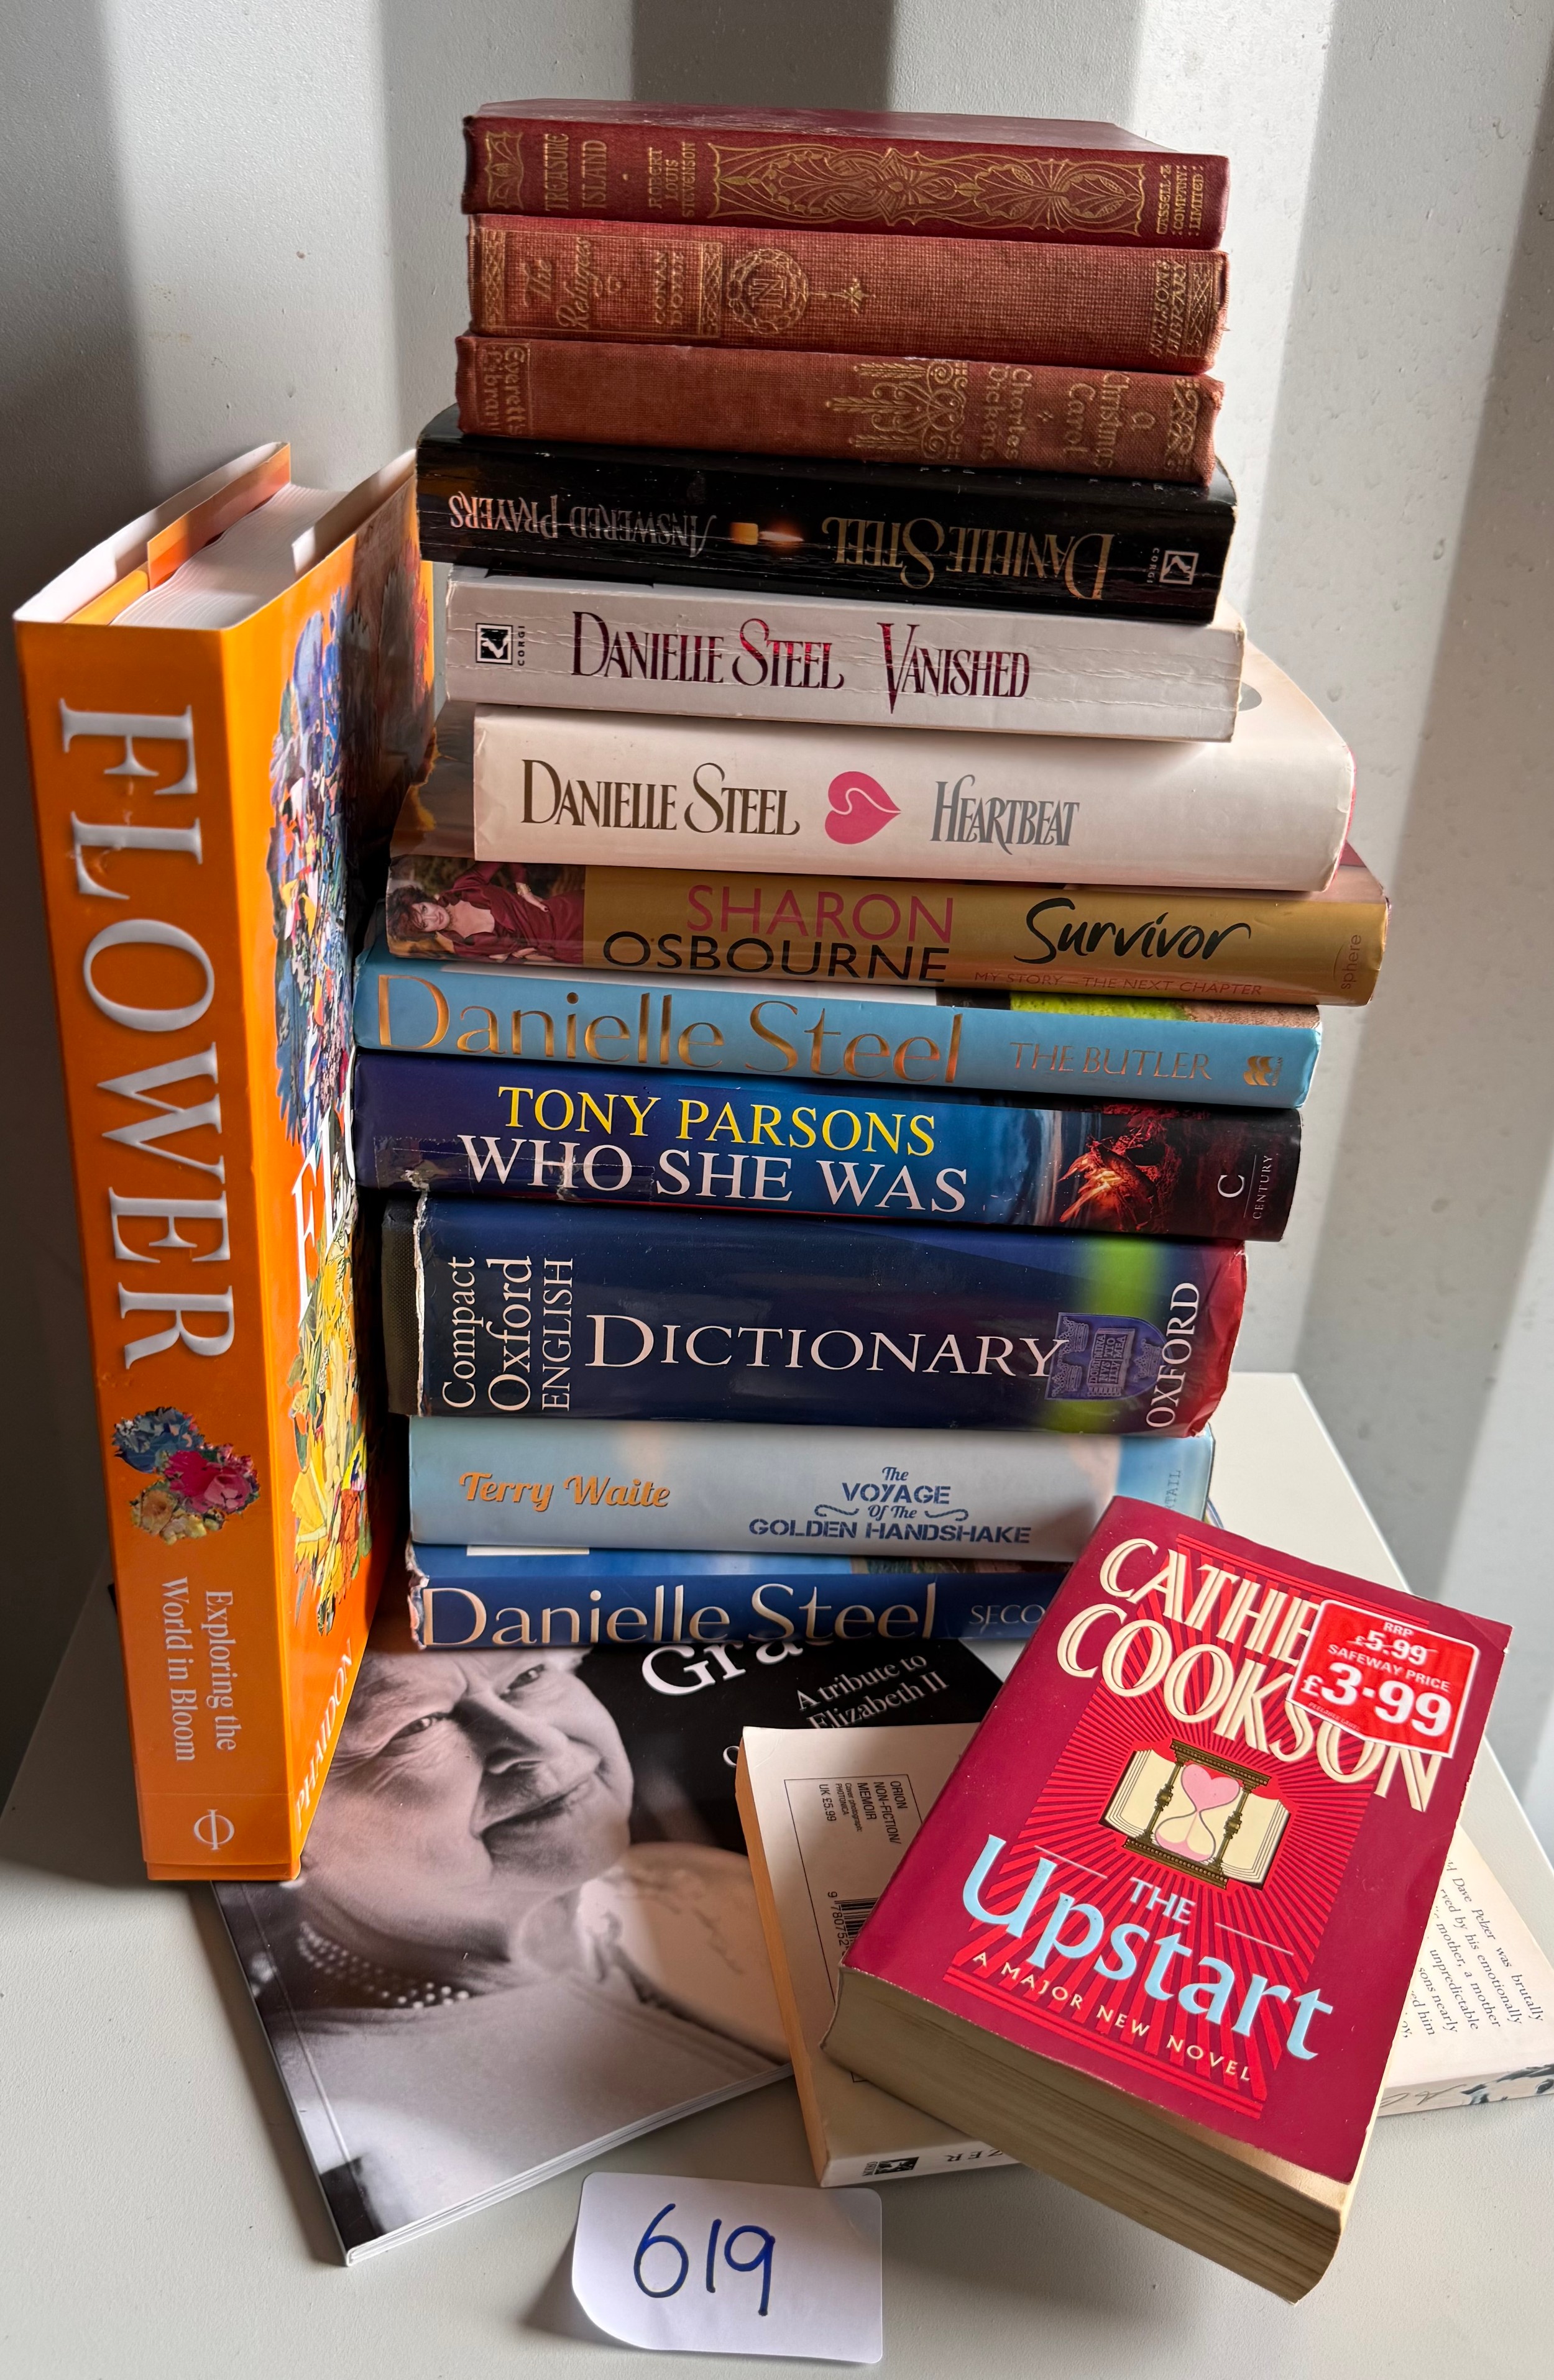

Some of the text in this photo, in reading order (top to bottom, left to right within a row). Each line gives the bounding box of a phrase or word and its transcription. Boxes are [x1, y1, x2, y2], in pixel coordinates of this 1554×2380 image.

[543, 132, 569, 211] TREASURE
[581, 139, 608, 209] ISLAND
[648, 147, 663, 209] ROBERT
[664, 159, 679, 201] LOUIS
[681, 141, 696, 219] STEVENSON
[1188, 173, 1205, 231] LIMITED
[1156, 183, 1172, 235] CASSELL
[522, 260, 554, 307] The
[556, 237, 603, 332] Refugees
[655, 251, 667, 326] CONAN
[670, 252, 684, 326] DOYLE
[980, 365, 1008, 460] Dickens
[1005, 367, 1033, 460] Charles
[1063, 383, 1096, 455] Carol
[1095, 371, 1130, 469] Christmas
[448, 492, 717, 557] ANSWERED PRAYERS
[822, 516, 1115, 601] DANIELLE STEEL
[1146, 547, 1161, 584] CORGI
[517, 625, 526, 667] CORGI
[572, 611, 845, 690] DANIELLE STEEL
[877, 622, 1031, 715] VANISHED
[521, 759, 801, 836] DANIELLE STEEL
[930, 774, 1080, 856] HEARTBEAT
[687, 884, 954, 943] SHARON
[1013, 897, 1251, 964] Survivor
[603, 930, 951, 984] OSBOURNE
[974, 972, 1262, 995] MY STORY THE NEXT CHAPTER
[1339, 933, 1361, 989] sphere
[57, 697, 236, 1371] FLOWER
[378, 974, 963, 1085] Danielle Steel
[1009, 1041, 1212, 1081] THE BUTLER
[498, 1086, 936, 1156] TONY PARSONS
[457, 1134, 967, 1214] WHO SHE WAS
[1252, 1155, 1273, 1220] CENTURY
[441, 1256, 484, 1408] Compact
[485, 1255, 532, 1411] Oxford
[541, 1257, 574, 1412] ENGLISH
[584, 1314, 1070, 1378] DICTIONARY
[1146, 1281, 1200, 1428] OXFORD
[459, 1471, 671, 1513] Terry Waite
[842, 1482, 951, 1504] VOYAGE
[881, 1466, 909, 1481] The
[1165, 1470, 1181, 1508] TAIL
[748, 1518, 1032, 1544] GOLDEN HANDSHAKE
[867, 1504, 917, 1521] Of The
[423, 1582, 1046, 1647] Danielle Steel SECO
[1100, 1538, 1322, 1667] CATHE
[1383, 1621, 1415, 1637] RRP
[162, 1576, 199, 1762] World in Bloom
[200, 1590, 242, 1752] Exploring the
[1326, 1644, 1452, 1693] SAFEWAY PRICE
[1353, 1629, 1428, 1666] £5.99
[797, 1655, 928, 1711] A tribute to
[807, 1682, 926, 1729] Elizabeth
[1057, 1603, 1445, 1813] COOKSON
[295, 1637, 353, 1833] PHAIDON
[819, 1784, 837, 1822] UK £5.99
[835, 1783, 849, 1815] PHOTONICA
[845, 1783, 854, 1799] Cover
[857, 1782, 877, 1820] MEMOIR
[873, 1782, 901, 1844] NON-FICTION/
[890, 1781, 908, 1809] ORION
[830, 1905, 849, 1956] 780752
[1131, 1877, 1197, 1924] THE
[962, 1834, 1333, 2061] Upstart
[1436, 1923, 1501, 2028] mother, a mother
[1452, 1877, 1544, 2022] Dave Pelzer was brutally
[1453, 1916, 1468, 1931] by
[1464, 1933, 1479, 1951] his
[1477, 1954, 1523, 2025] emotionally
[972, 1951, 1251, 2082] A MAJOR NEW NOVEL
[1430, 1949, 1479, 2031] unpredictable
[1432, 1995, 1458, 2033] nearly
[1417, 2011, 1436, 2036] him
[944, 2149, 1003, 2163] ZER
[633, 2203, 776, 2316] 619
